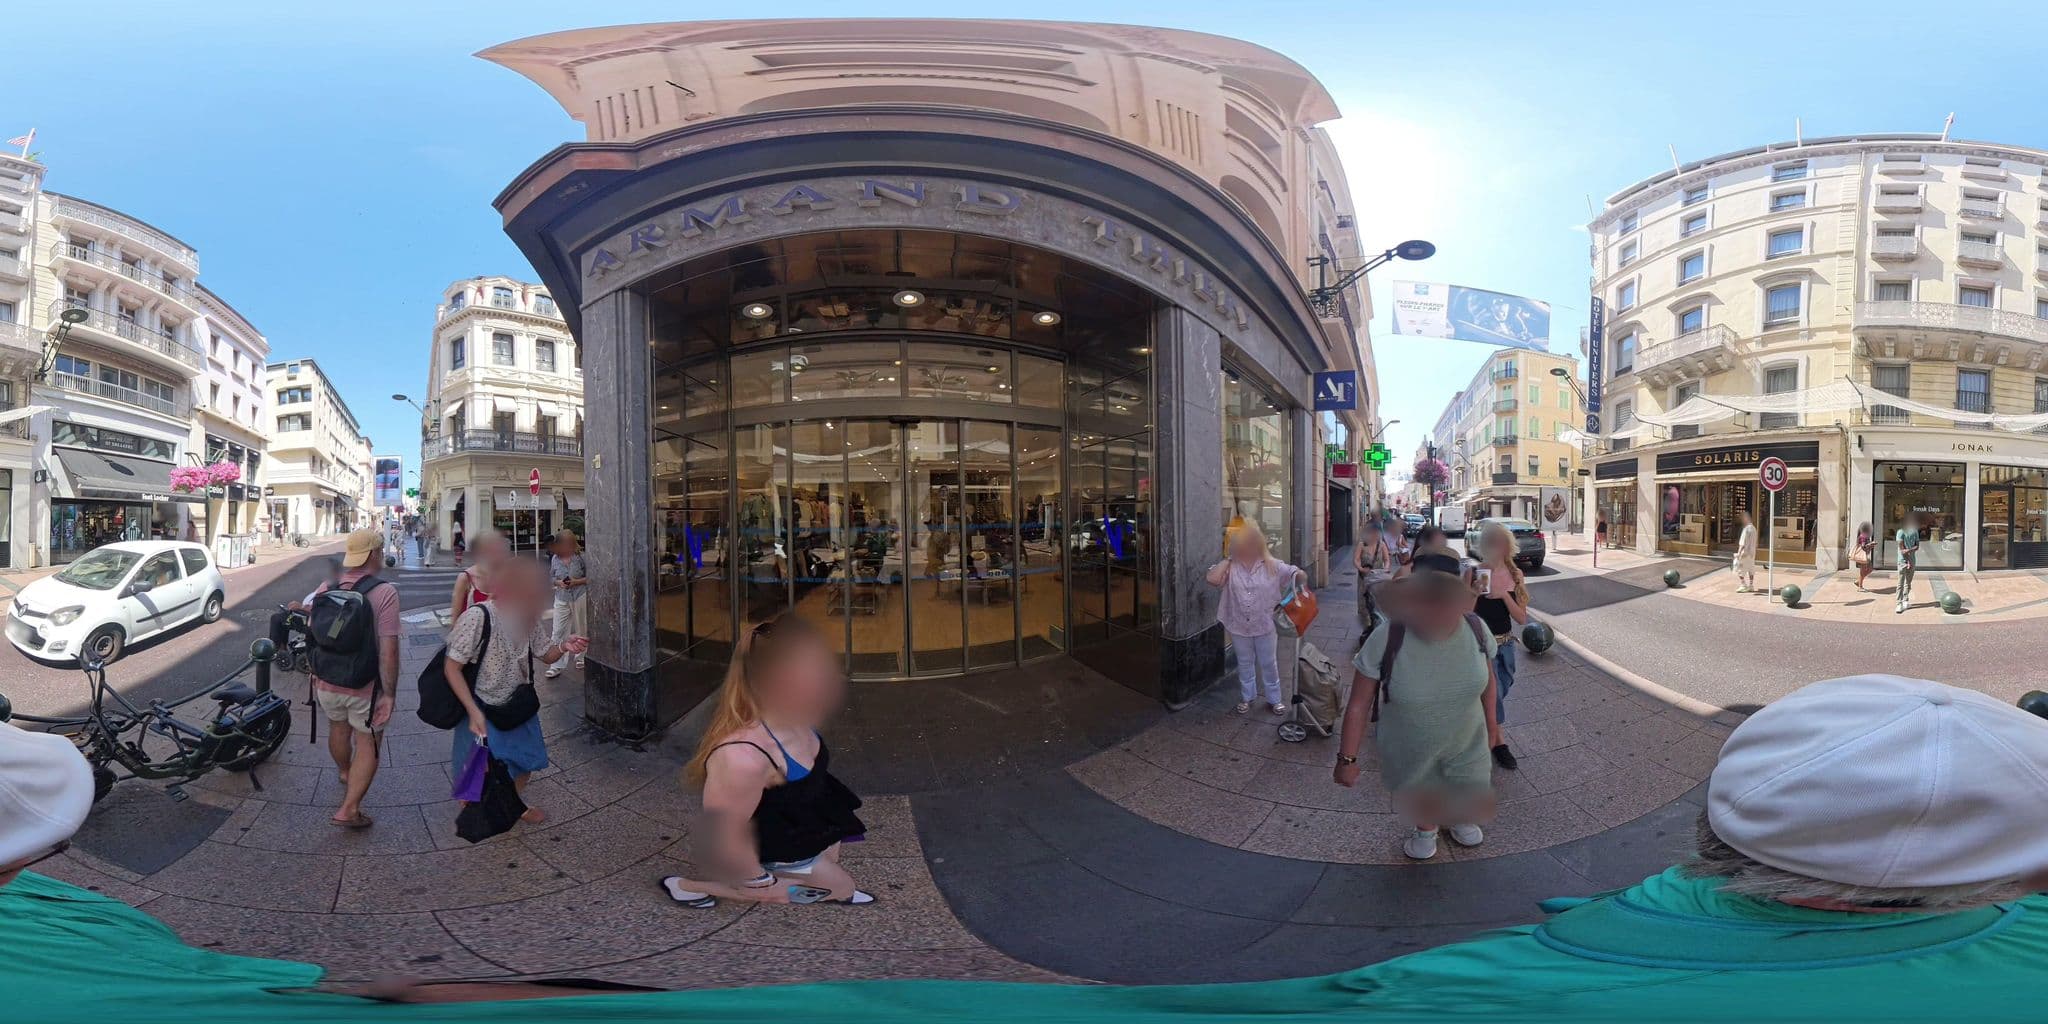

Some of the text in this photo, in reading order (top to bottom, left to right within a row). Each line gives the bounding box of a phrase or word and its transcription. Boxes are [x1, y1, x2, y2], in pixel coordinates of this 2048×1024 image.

[586, 179, 1021, 281] ARMAND
[1591, 298, 1600, 397] HOTEL UNIVERS
[1951, 443, 1993, 453] JONAK
[1695, 450, 1760, 465] SOLARIS
[1765, 466, 1782, 482] 30
